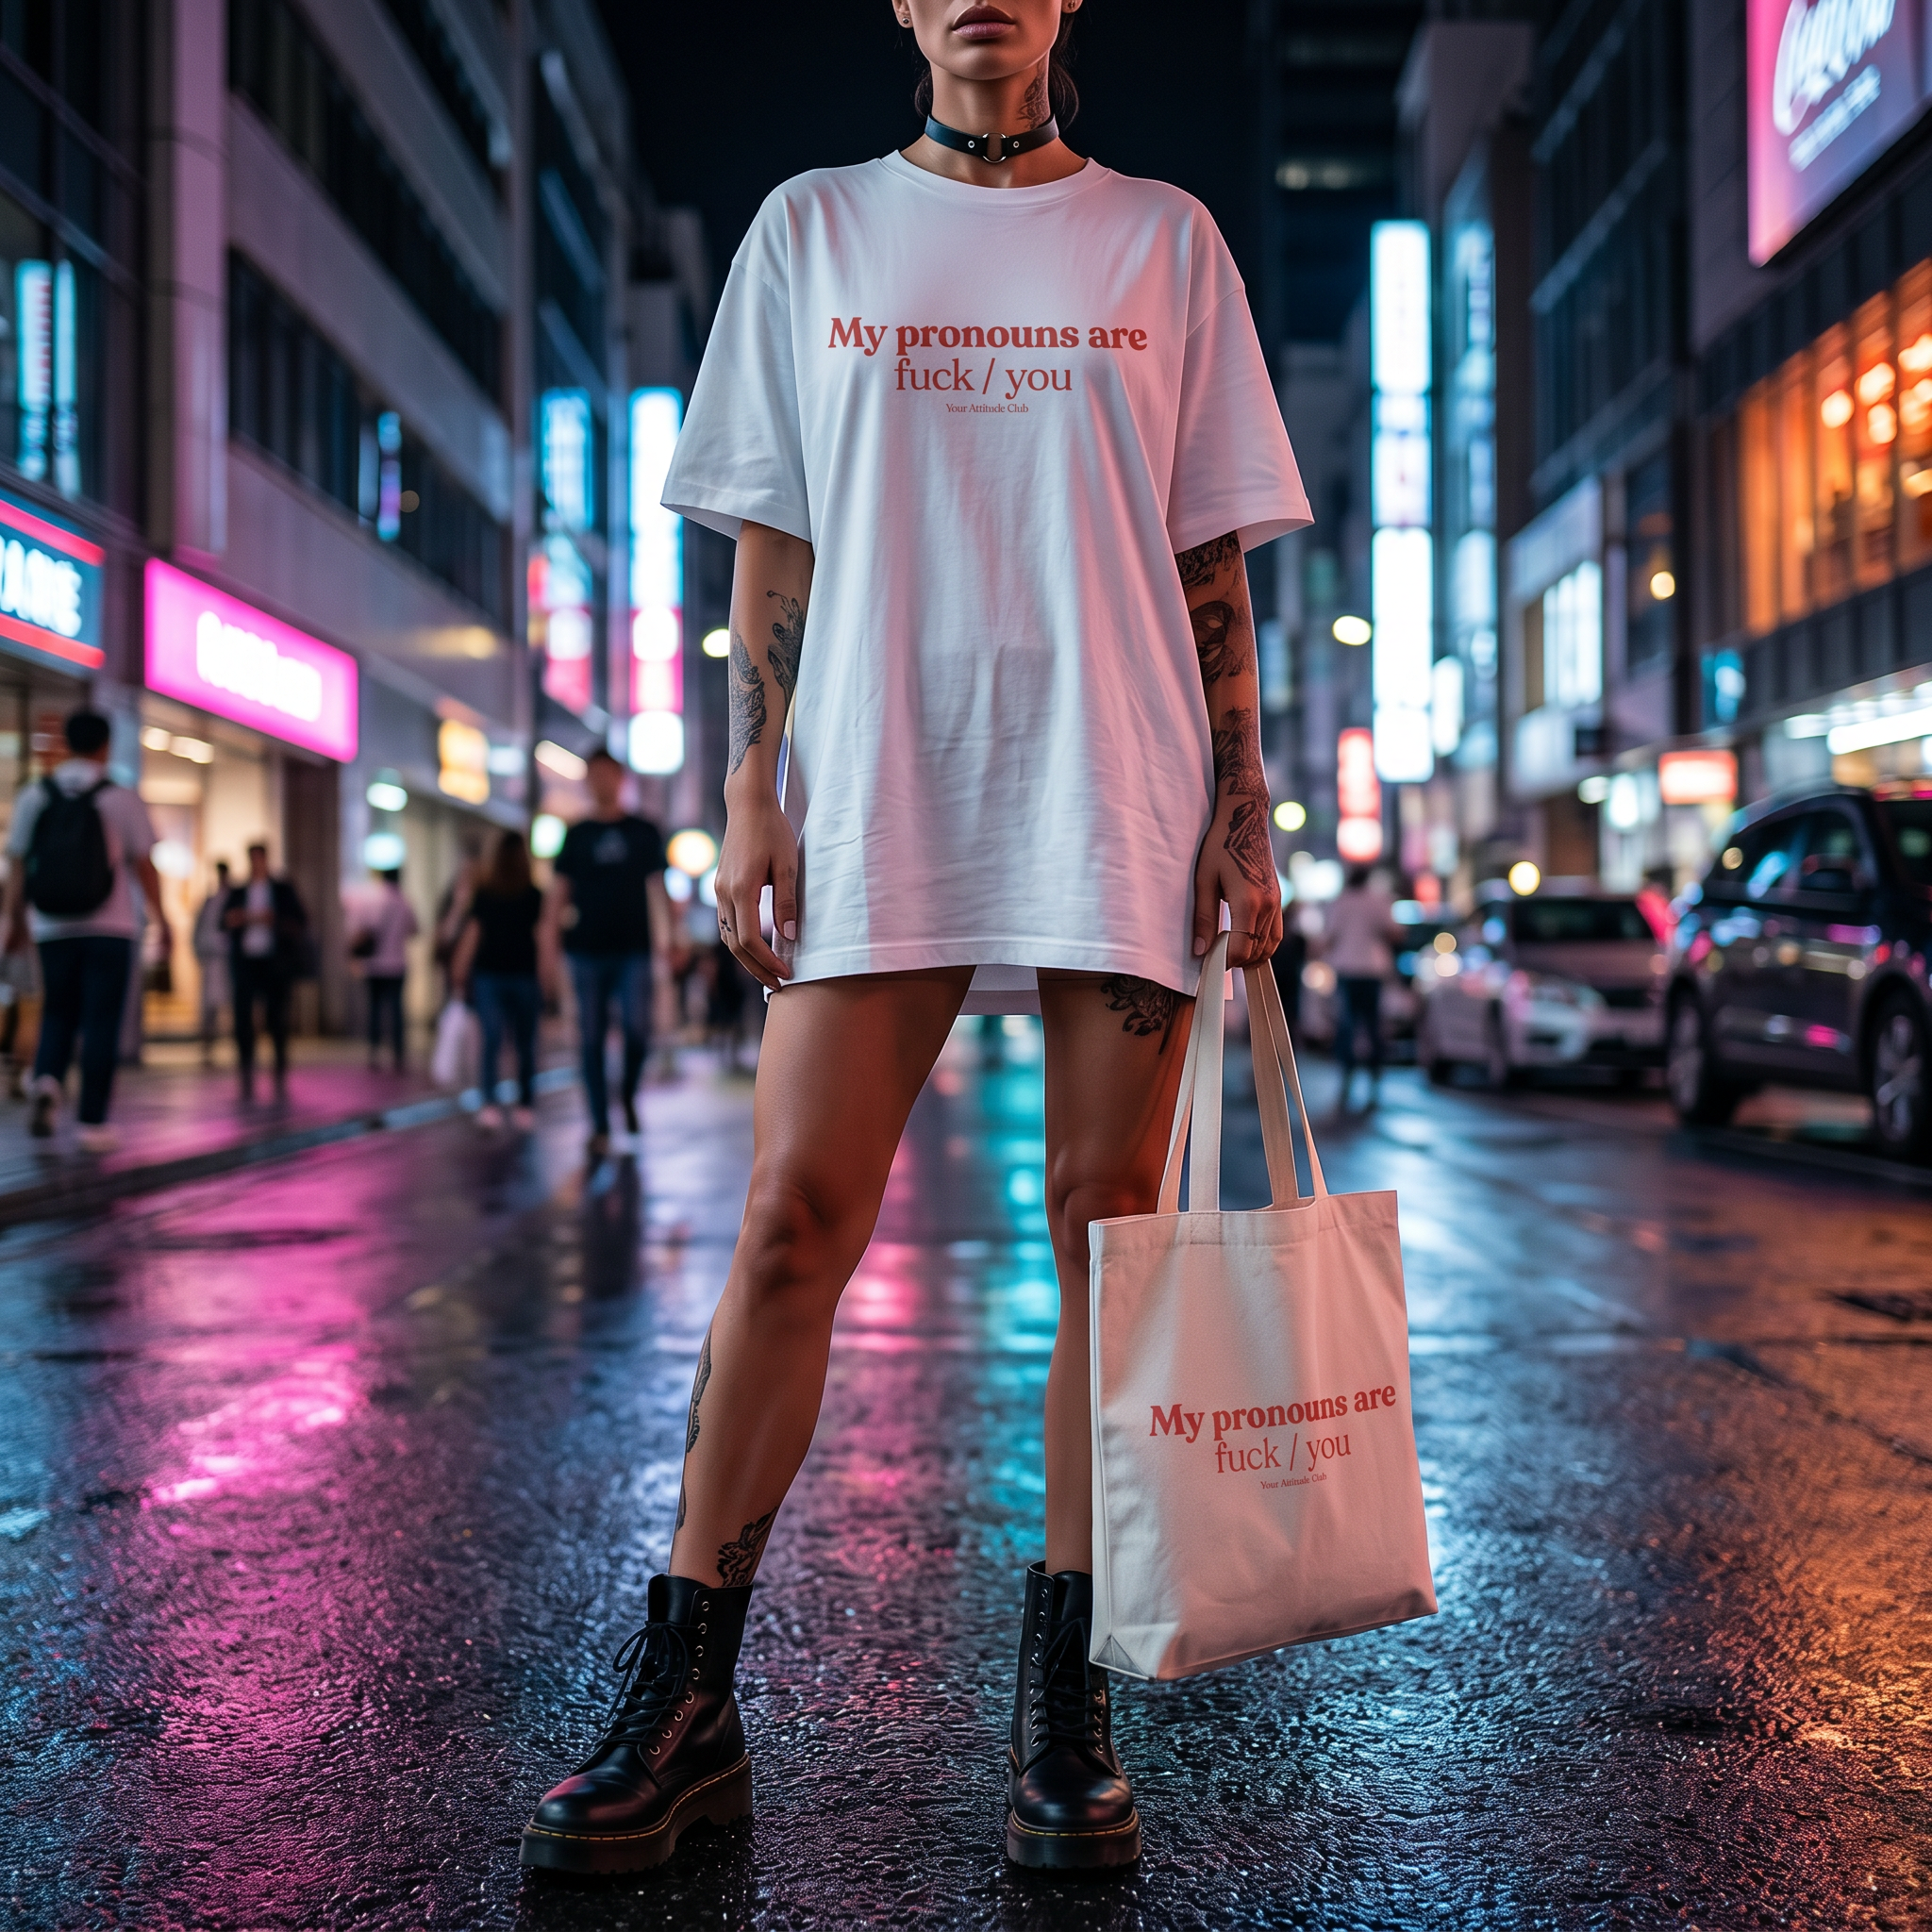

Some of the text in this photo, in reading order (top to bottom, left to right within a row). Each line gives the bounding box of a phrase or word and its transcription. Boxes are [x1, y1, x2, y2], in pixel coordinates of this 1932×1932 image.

[827, 316, 1148, 357] My pronouns are
[894, 358, 1073, 400] fuck / you
[945, 403, 1029, 413] Your Attitude Club
[1149, 1385, 1396, 1443] My pronouns are
[1215, 1433, 1352, 1474] fuck / you
[1260, 1481, 1279, 1490] Your
